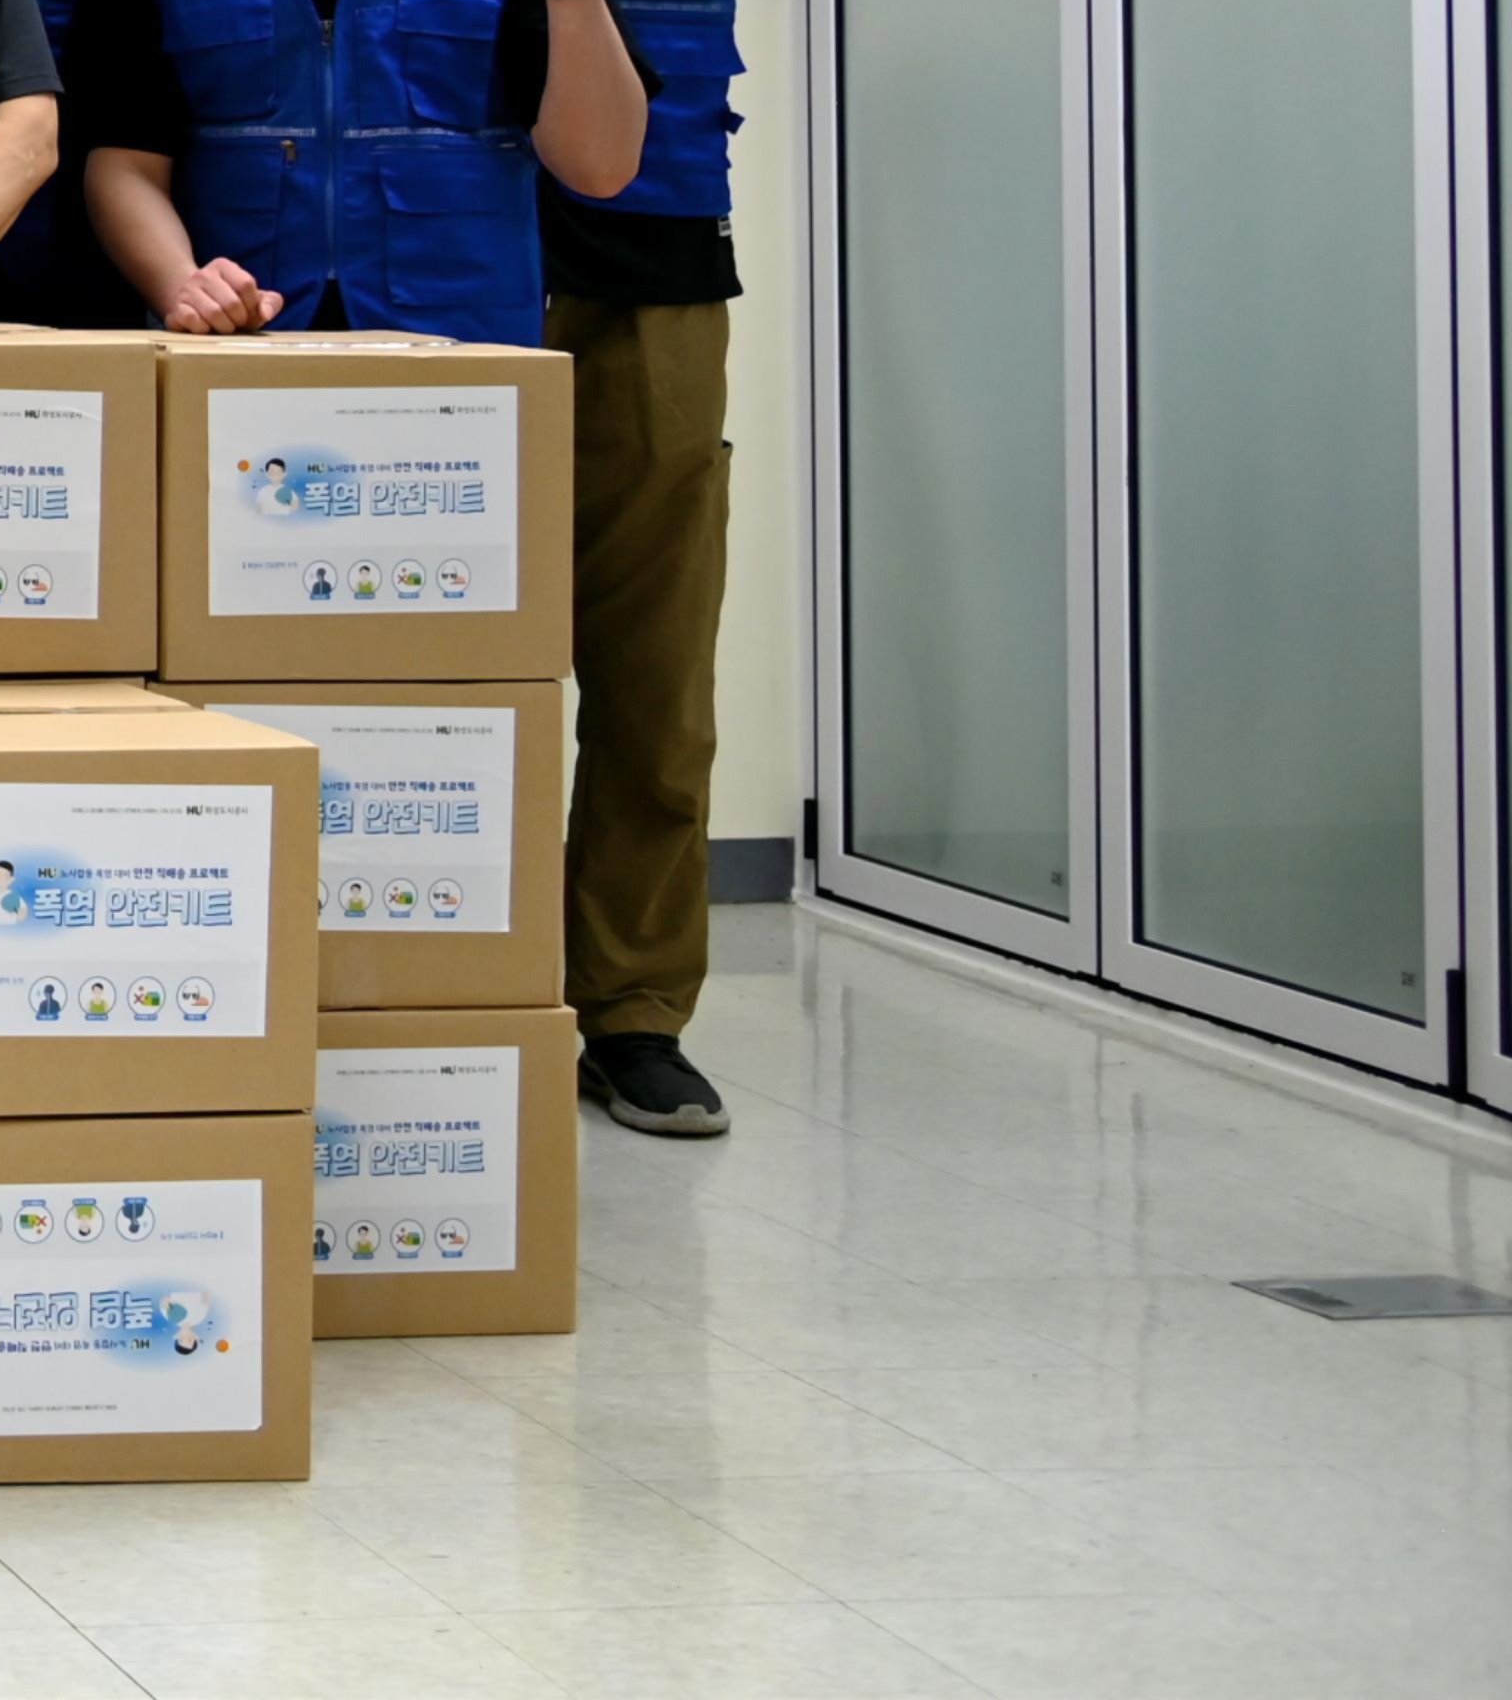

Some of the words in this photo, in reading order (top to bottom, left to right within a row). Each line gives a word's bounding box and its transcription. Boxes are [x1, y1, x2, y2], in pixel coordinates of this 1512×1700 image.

[303, 480, 361, 518] 폭염
[368, 476, 485, 517] 안전키트
[319, 800, 354, 834] 염
[362, 797, 479, 835] 안전키트
[32, 887, 96, 928] 폭염
[105, 885, 233, 928] 안전키트
[368, 1136, 485, 1177] 안전키트
[89, 1289, 155, 1331] 폭염
